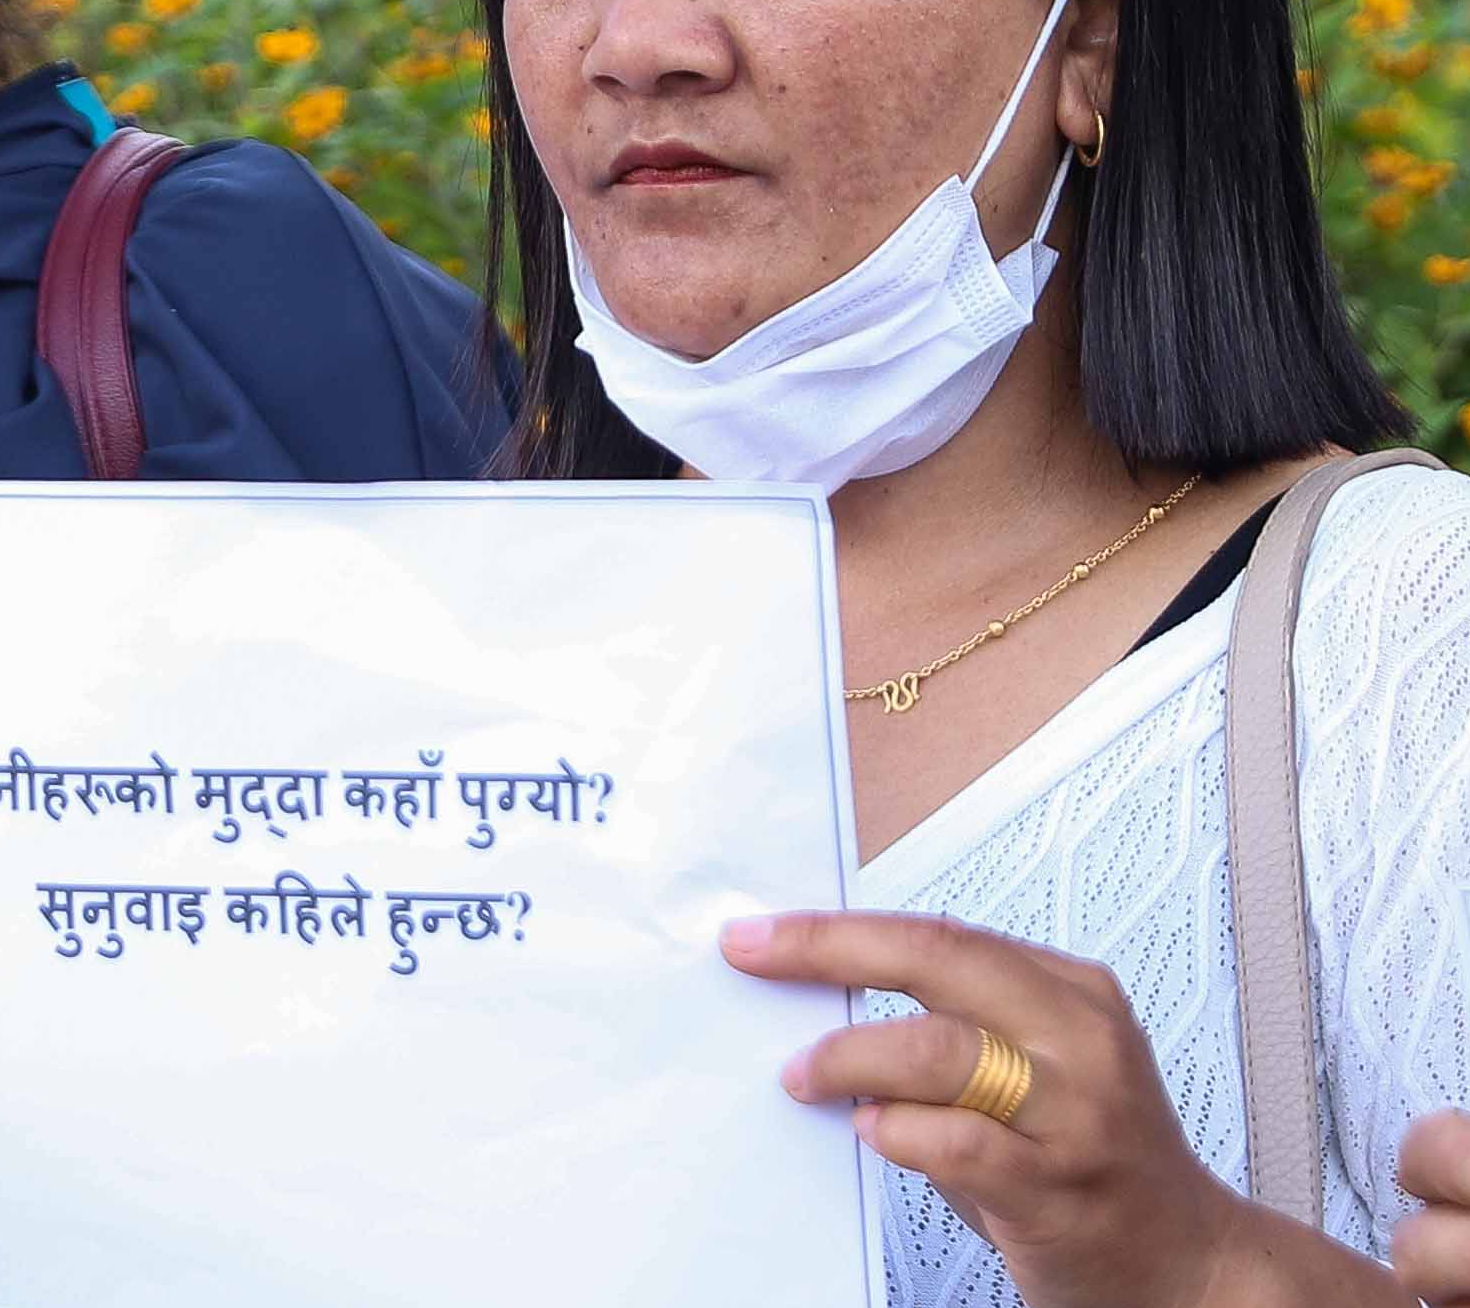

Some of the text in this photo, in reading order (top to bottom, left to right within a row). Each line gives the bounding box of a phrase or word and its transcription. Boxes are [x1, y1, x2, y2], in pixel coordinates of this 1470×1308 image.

[341, 749, 444, 830] कहाँ
[456, 756, 614, 850] पुग्यो?
[35, 870, 533, 976] सुनुवाइ कहिले हुन्छ?
